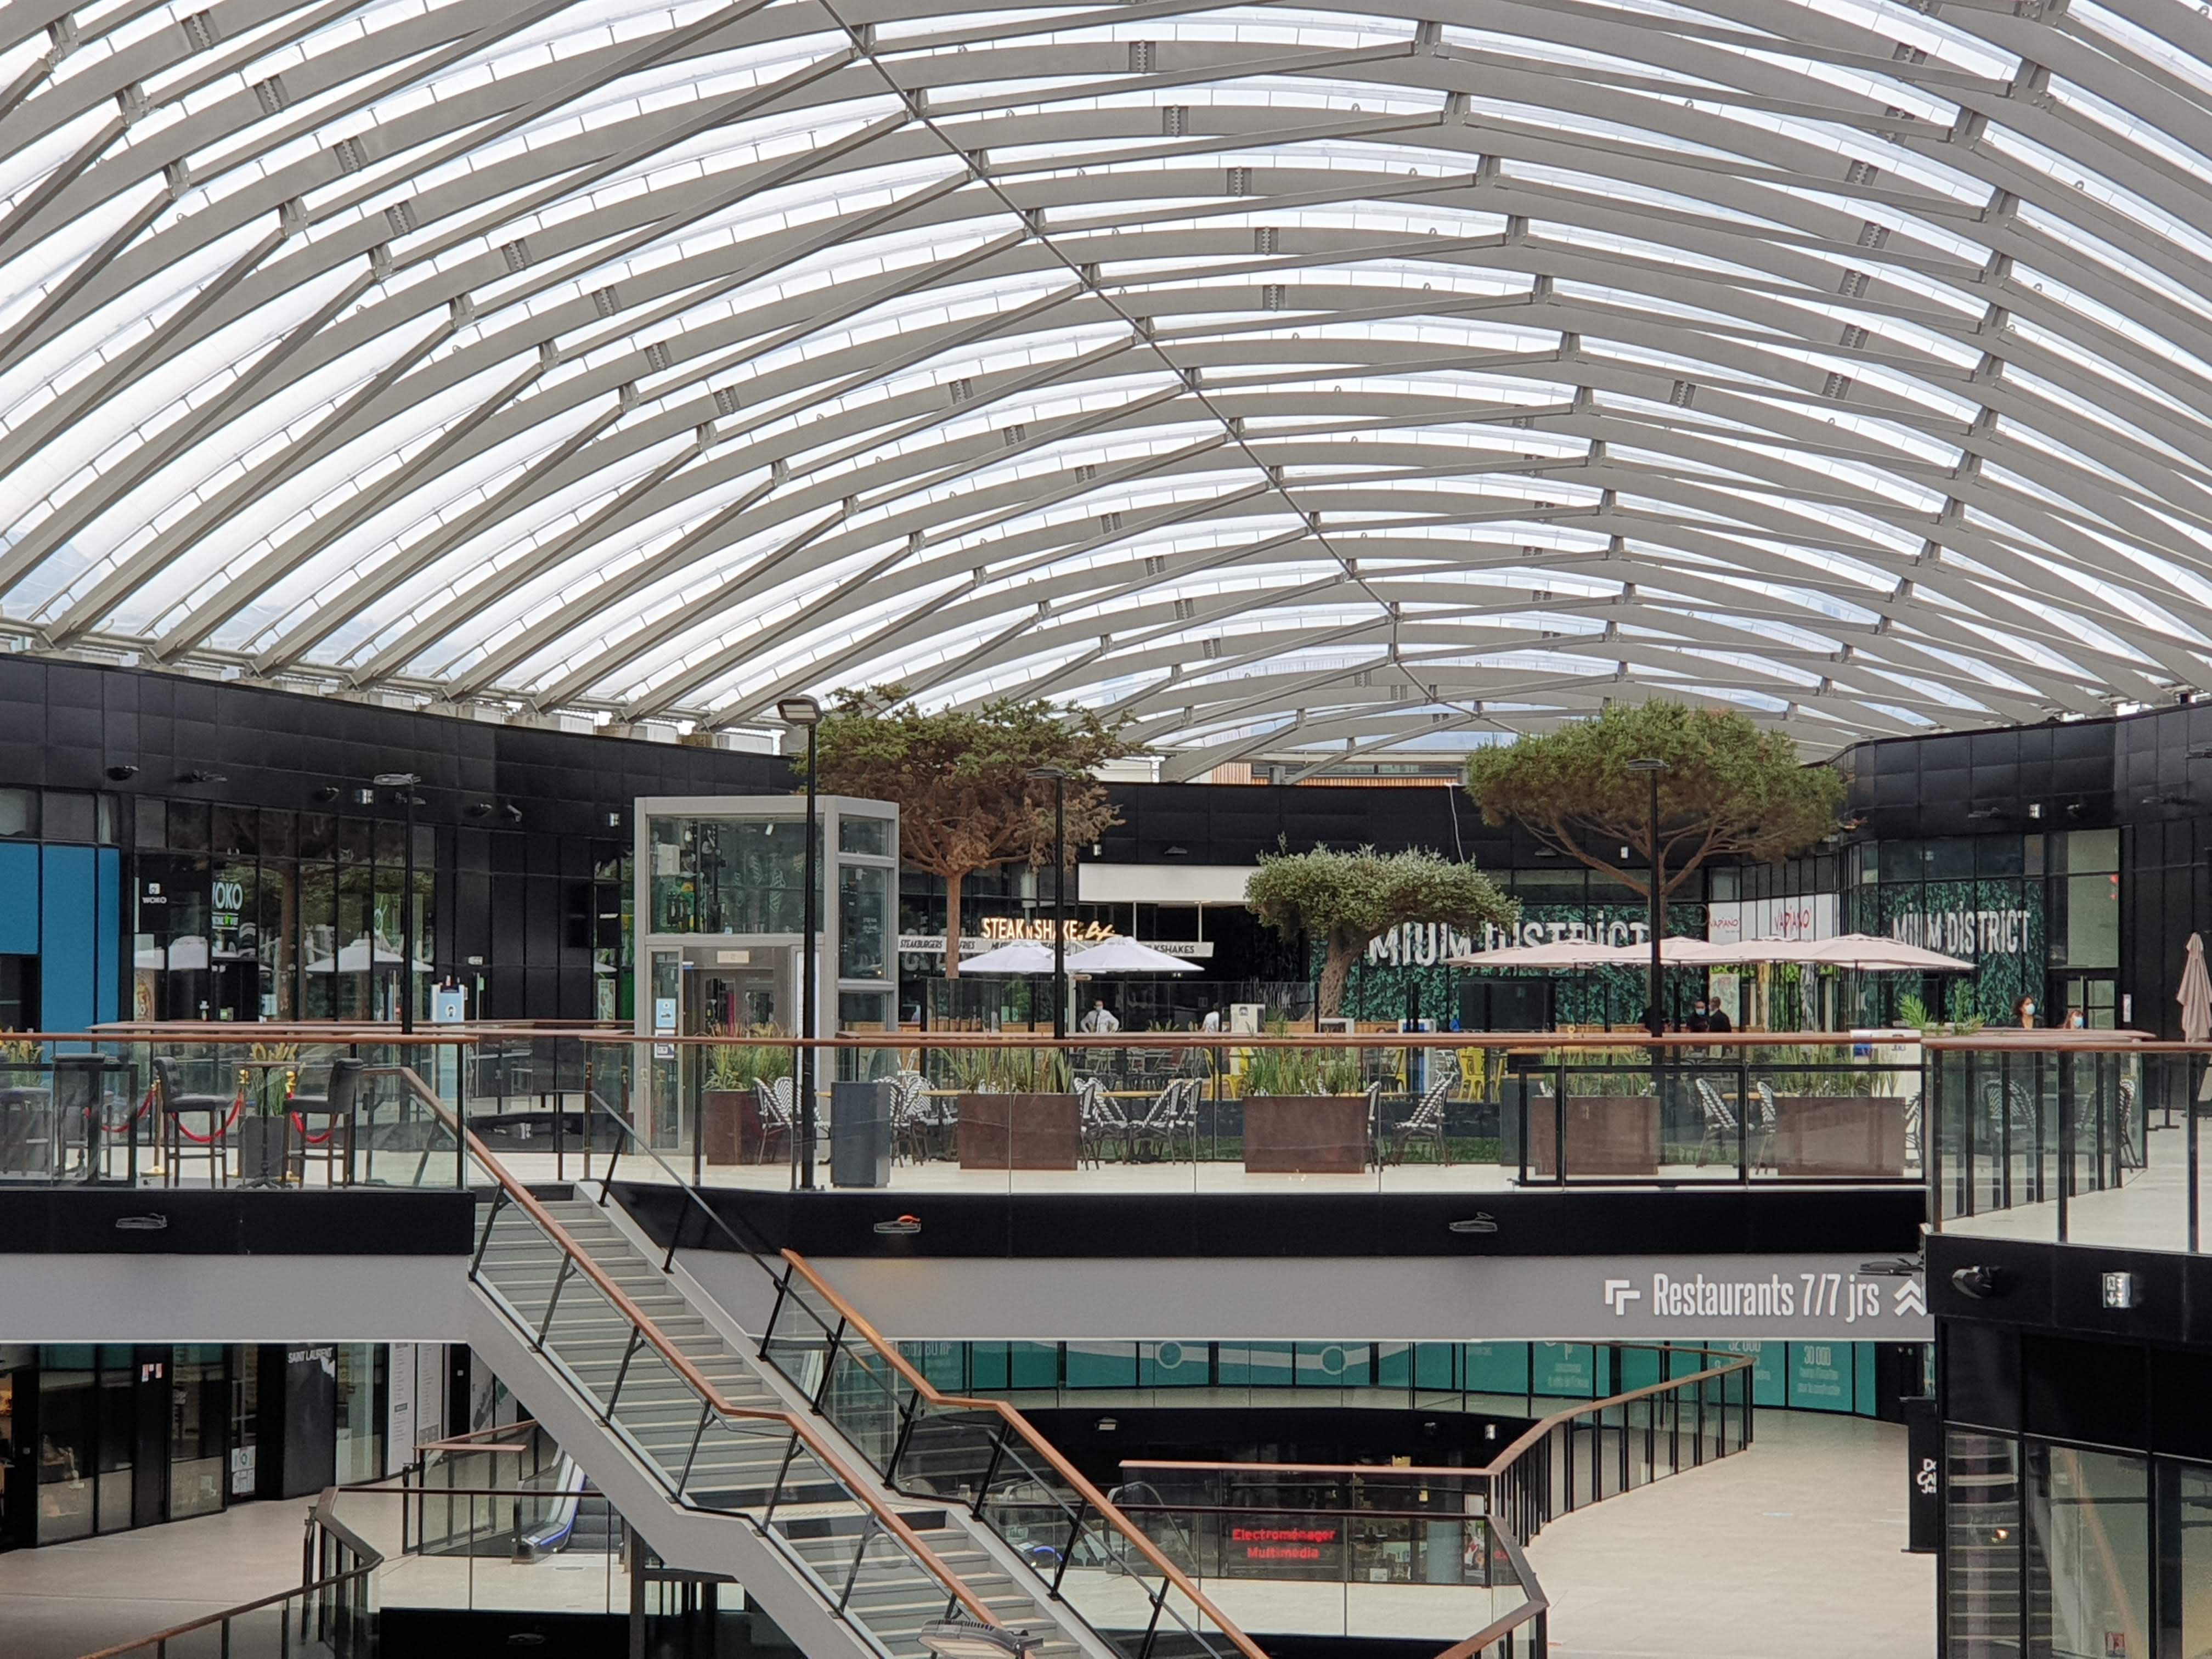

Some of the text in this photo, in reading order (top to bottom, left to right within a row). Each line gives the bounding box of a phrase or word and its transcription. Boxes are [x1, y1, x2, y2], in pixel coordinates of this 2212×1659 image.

[981, 918, 1025, 939] STEAK
[1143, 944, 1194, 953] KSHAKES
[1653, 1273, 1880, 1323] Restaurants 7/7 jrs
